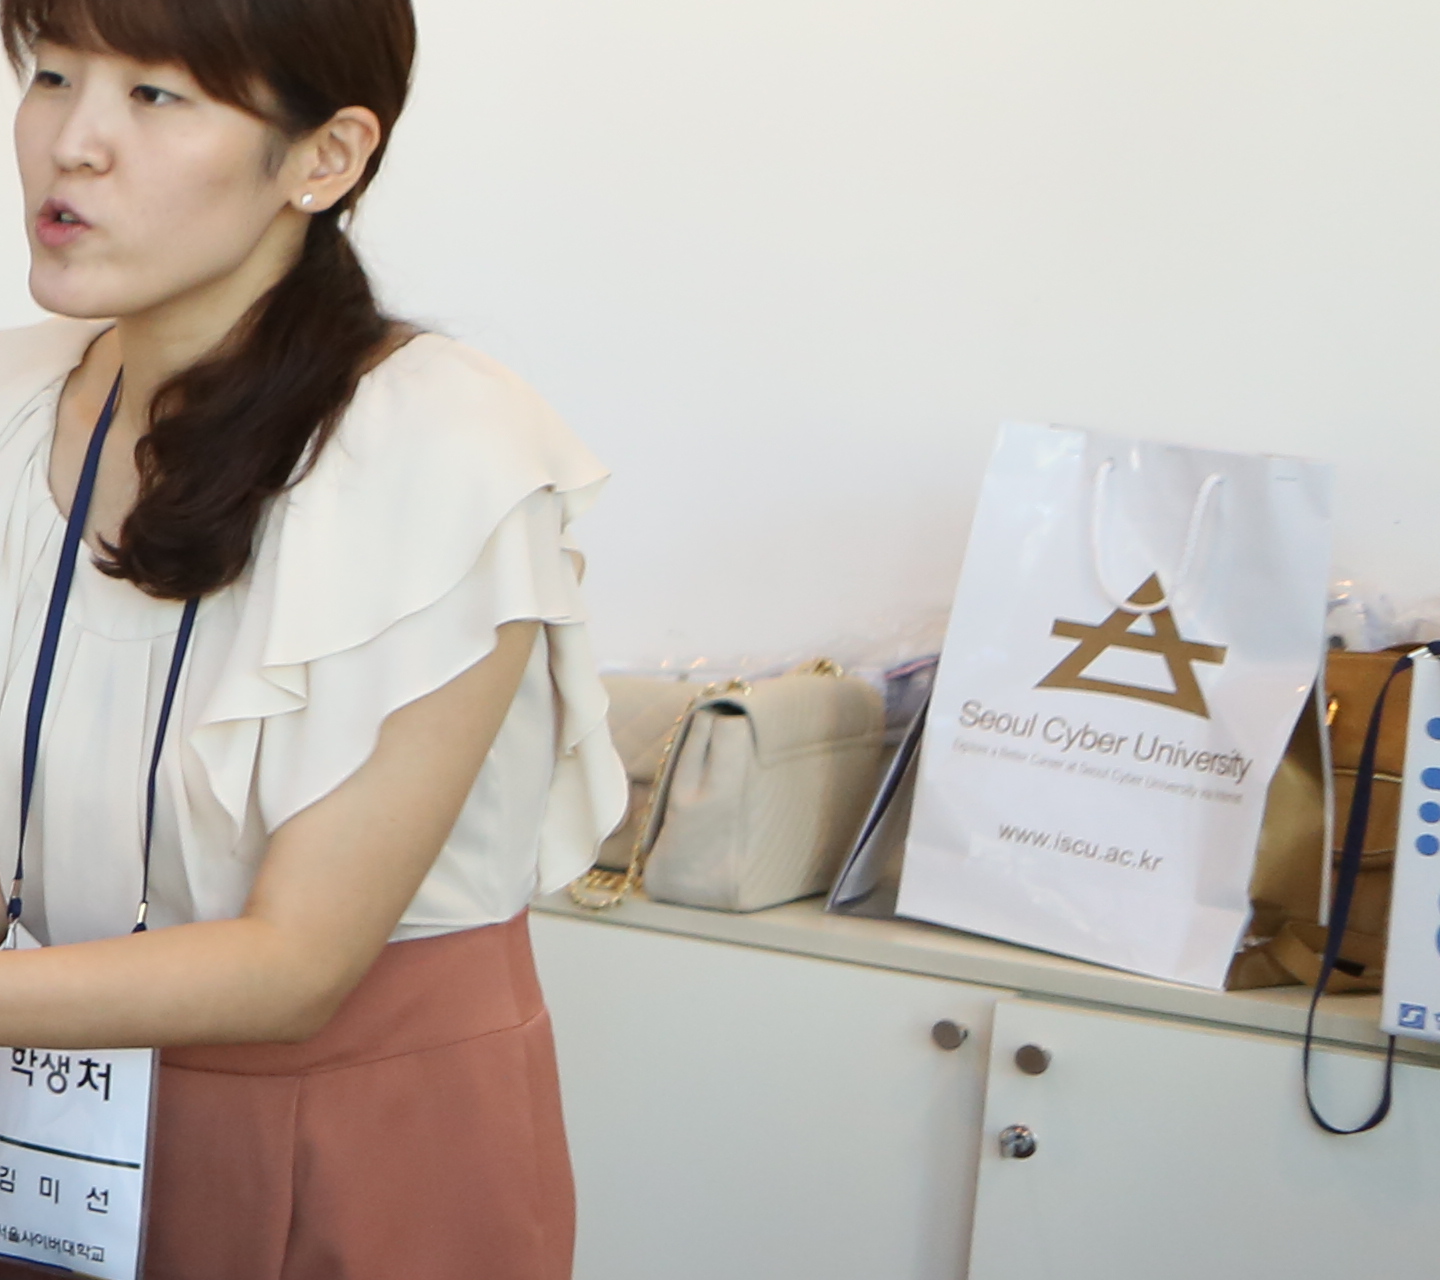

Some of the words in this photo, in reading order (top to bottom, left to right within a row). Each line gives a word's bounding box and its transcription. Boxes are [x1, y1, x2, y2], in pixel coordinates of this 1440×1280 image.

[958, 699, 1039, 738] Seoul
[1042, 716, 1128, 755] Cyber
[1133, 732, 1254, 784] University
[998, 823, 1165, 872] www.iscu.ac.kr
